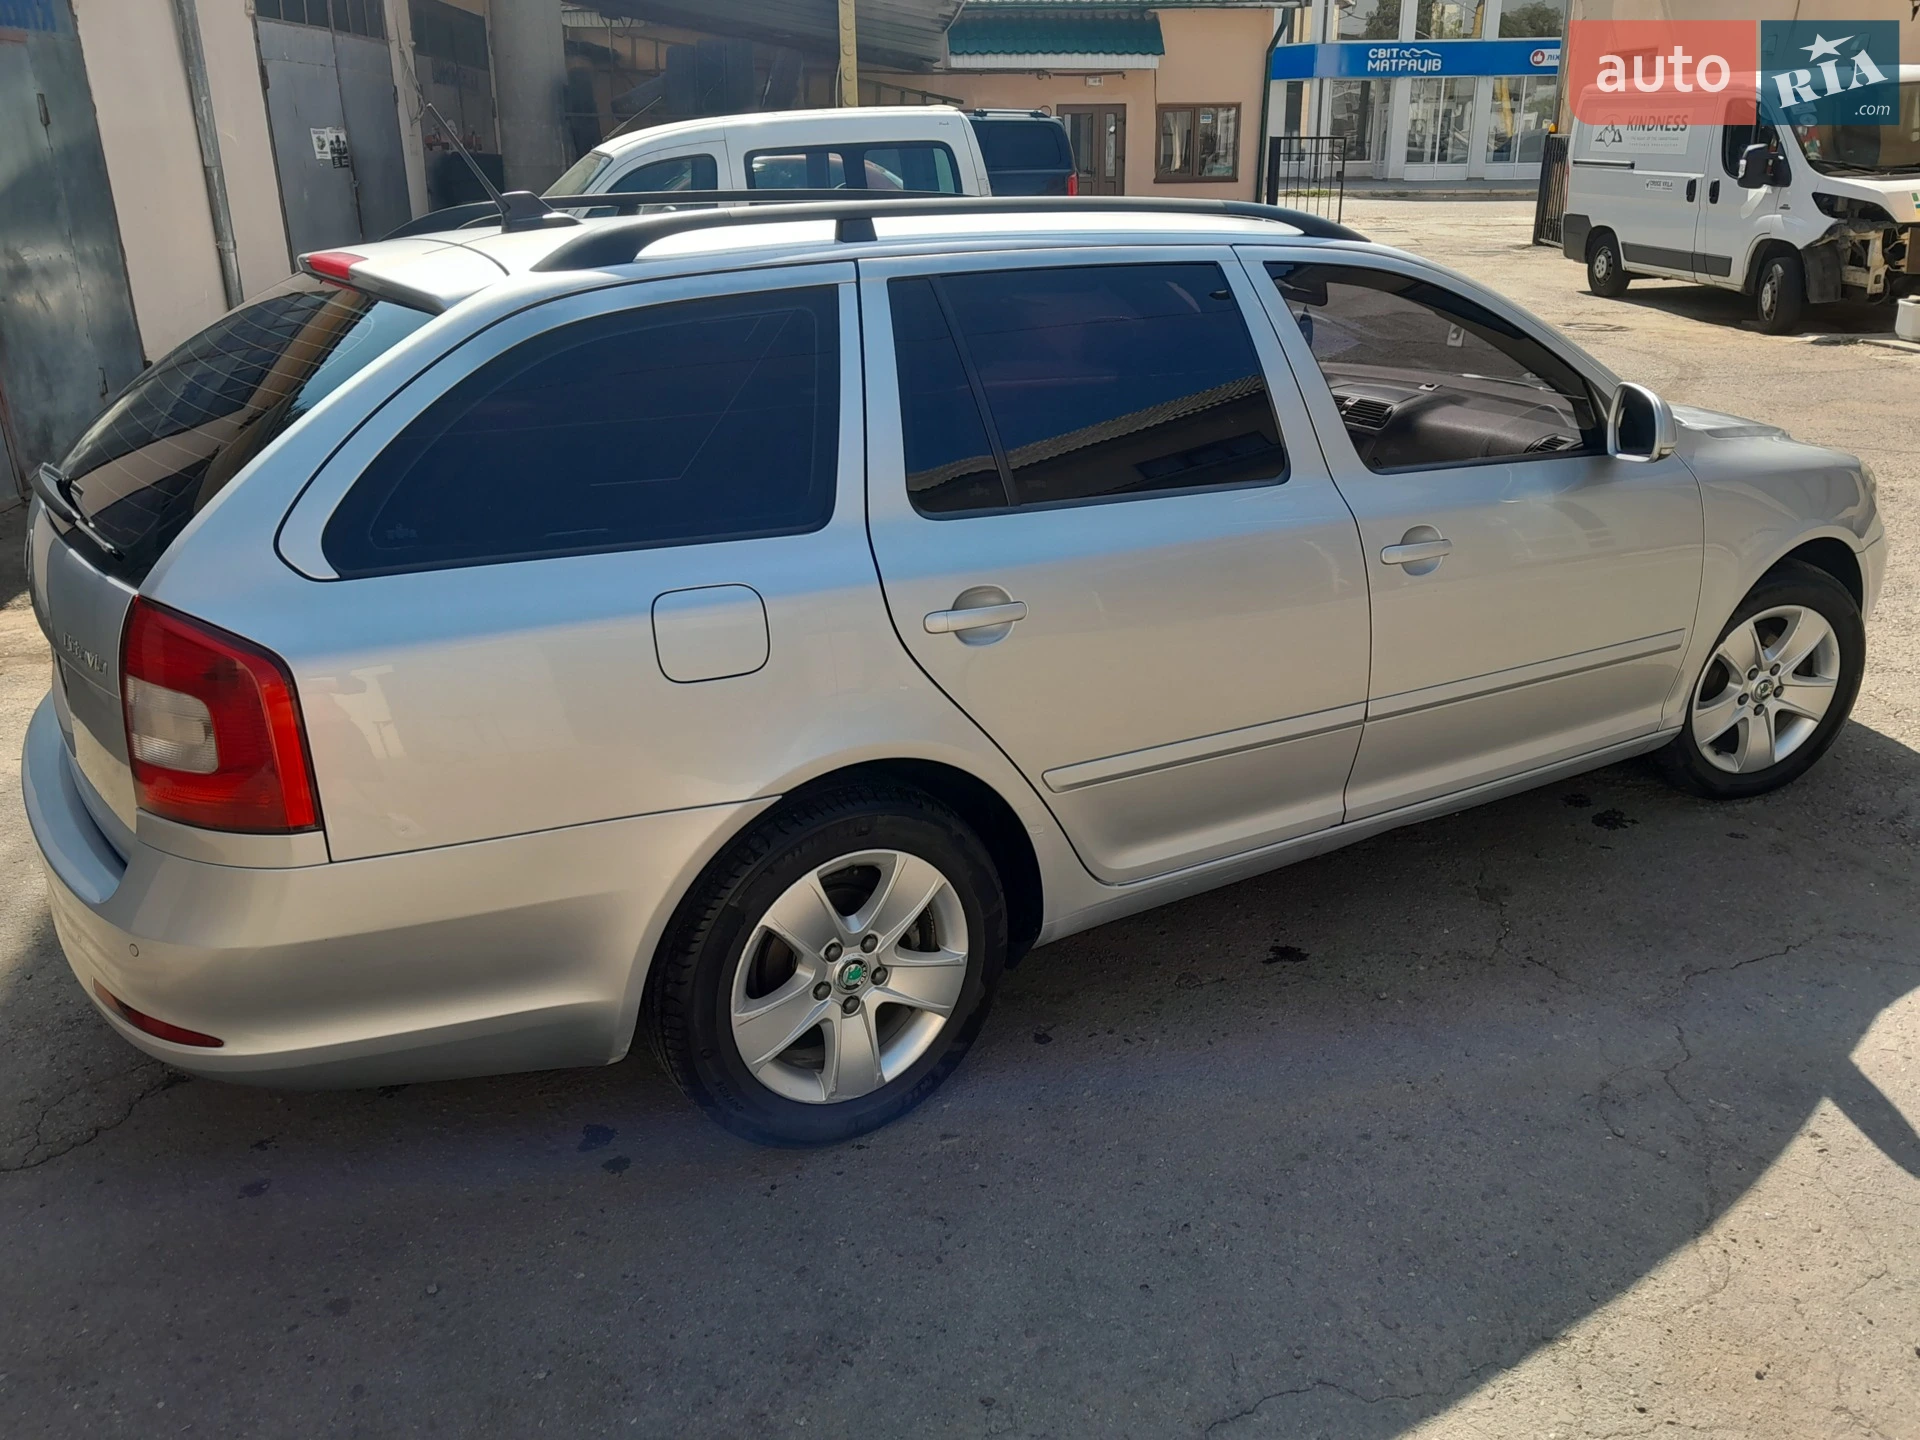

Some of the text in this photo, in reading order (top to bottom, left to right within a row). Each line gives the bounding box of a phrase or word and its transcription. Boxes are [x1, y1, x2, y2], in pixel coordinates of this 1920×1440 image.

[1368, 48, 1399, 59] СВІТ
[1367, 58, 1442, 73] МАТРАЦІВ
[1626, 114, 1689, 132] KINDNESS
